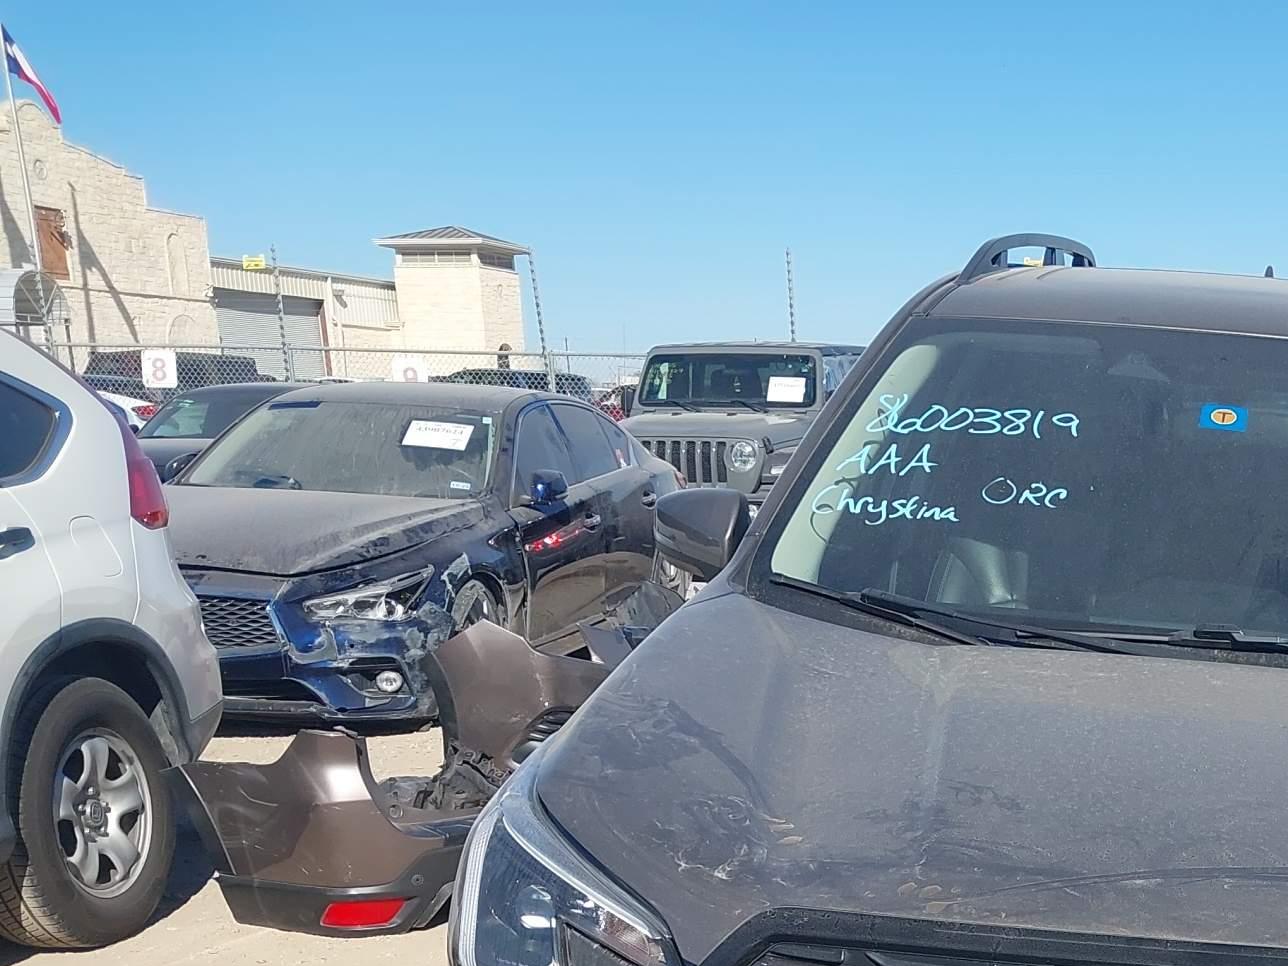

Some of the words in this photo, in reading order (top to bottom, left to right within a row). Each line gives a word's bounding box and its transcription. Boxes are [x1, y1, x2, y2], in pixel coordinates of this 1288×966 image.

[152, 358, 168, 381] 8
[836, 443, 939, 476] AAA
[811, 484, 961, 525] Chrystina
[982, 477, 1068, 508] ORC
